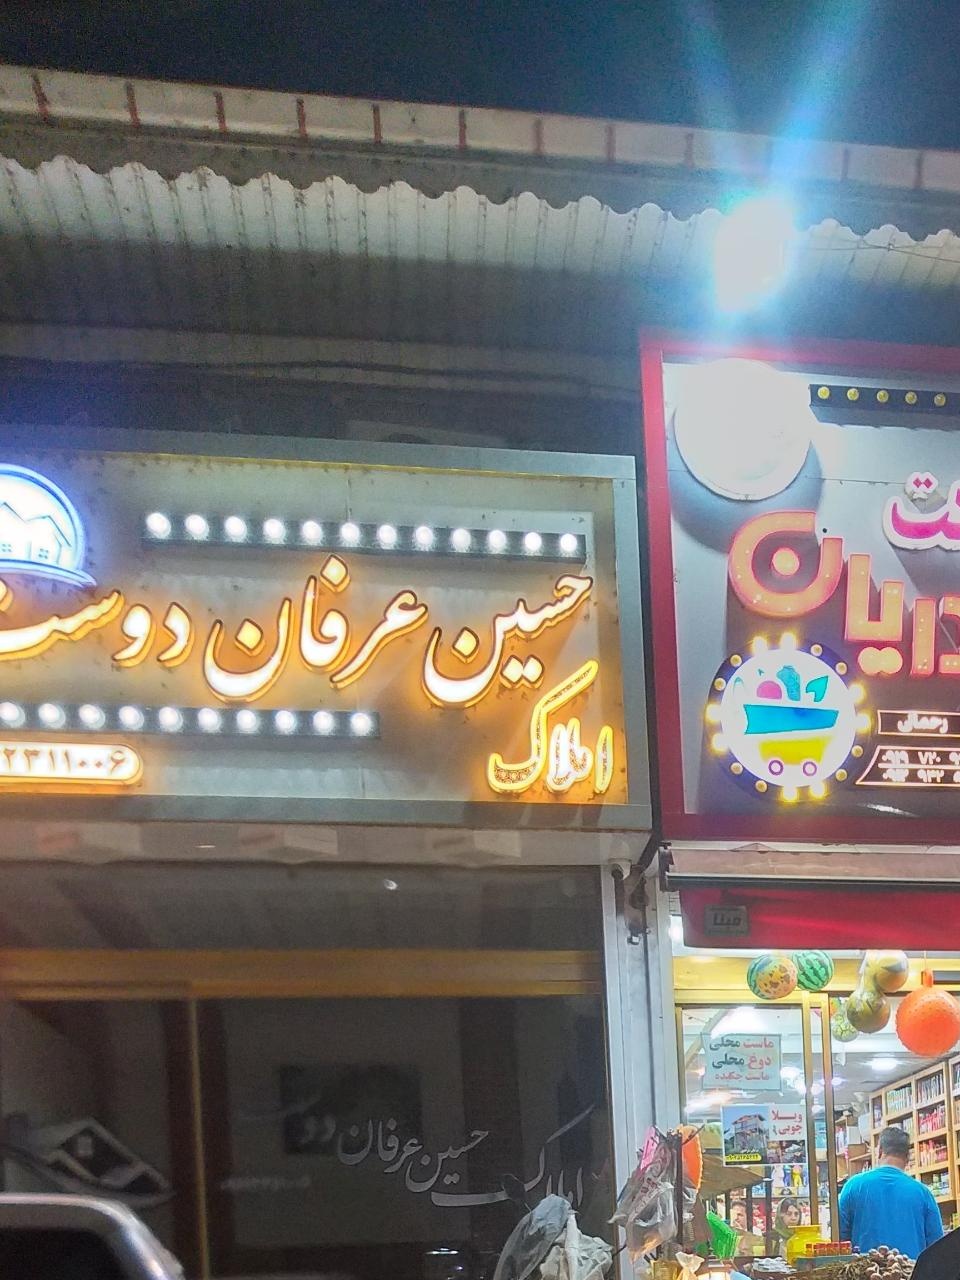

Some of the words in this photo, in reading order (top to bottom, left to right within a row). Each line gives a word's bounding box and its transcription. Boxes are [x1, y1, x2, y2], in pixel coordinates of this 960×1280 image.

[201, 554, 428, 701] عرفان
[422, 575, 593, 706] حسین
[487, 660, 615, 794] املاک
[709, 1036, 741, 1051] محلی
[712, 1053, 745, 1069] محلی
[337, 1118, 423, 1174] عرفان
[405, 1129, 489, 1193] حسین
